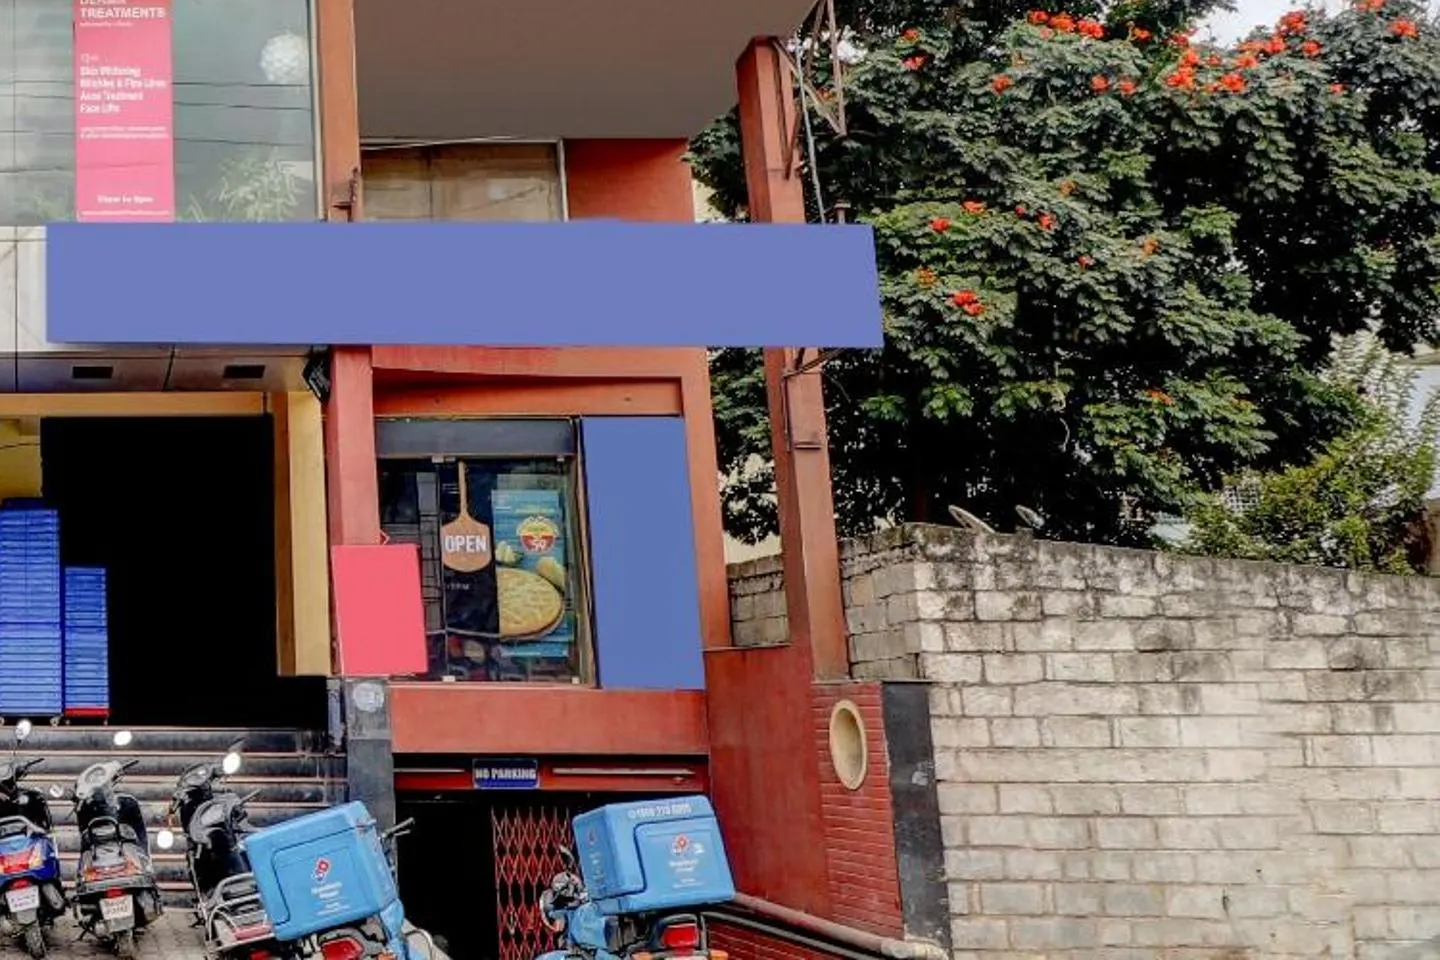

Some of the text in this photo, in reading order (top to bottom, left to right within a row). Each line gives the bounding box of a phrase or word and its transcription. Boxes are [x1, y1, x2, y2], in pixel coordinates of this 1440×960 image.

[80, 7, 167, 18] TREATMENTS
[444, 534, 487, 552] OPEN
[475, 767, 537, 780] NO PARKING
